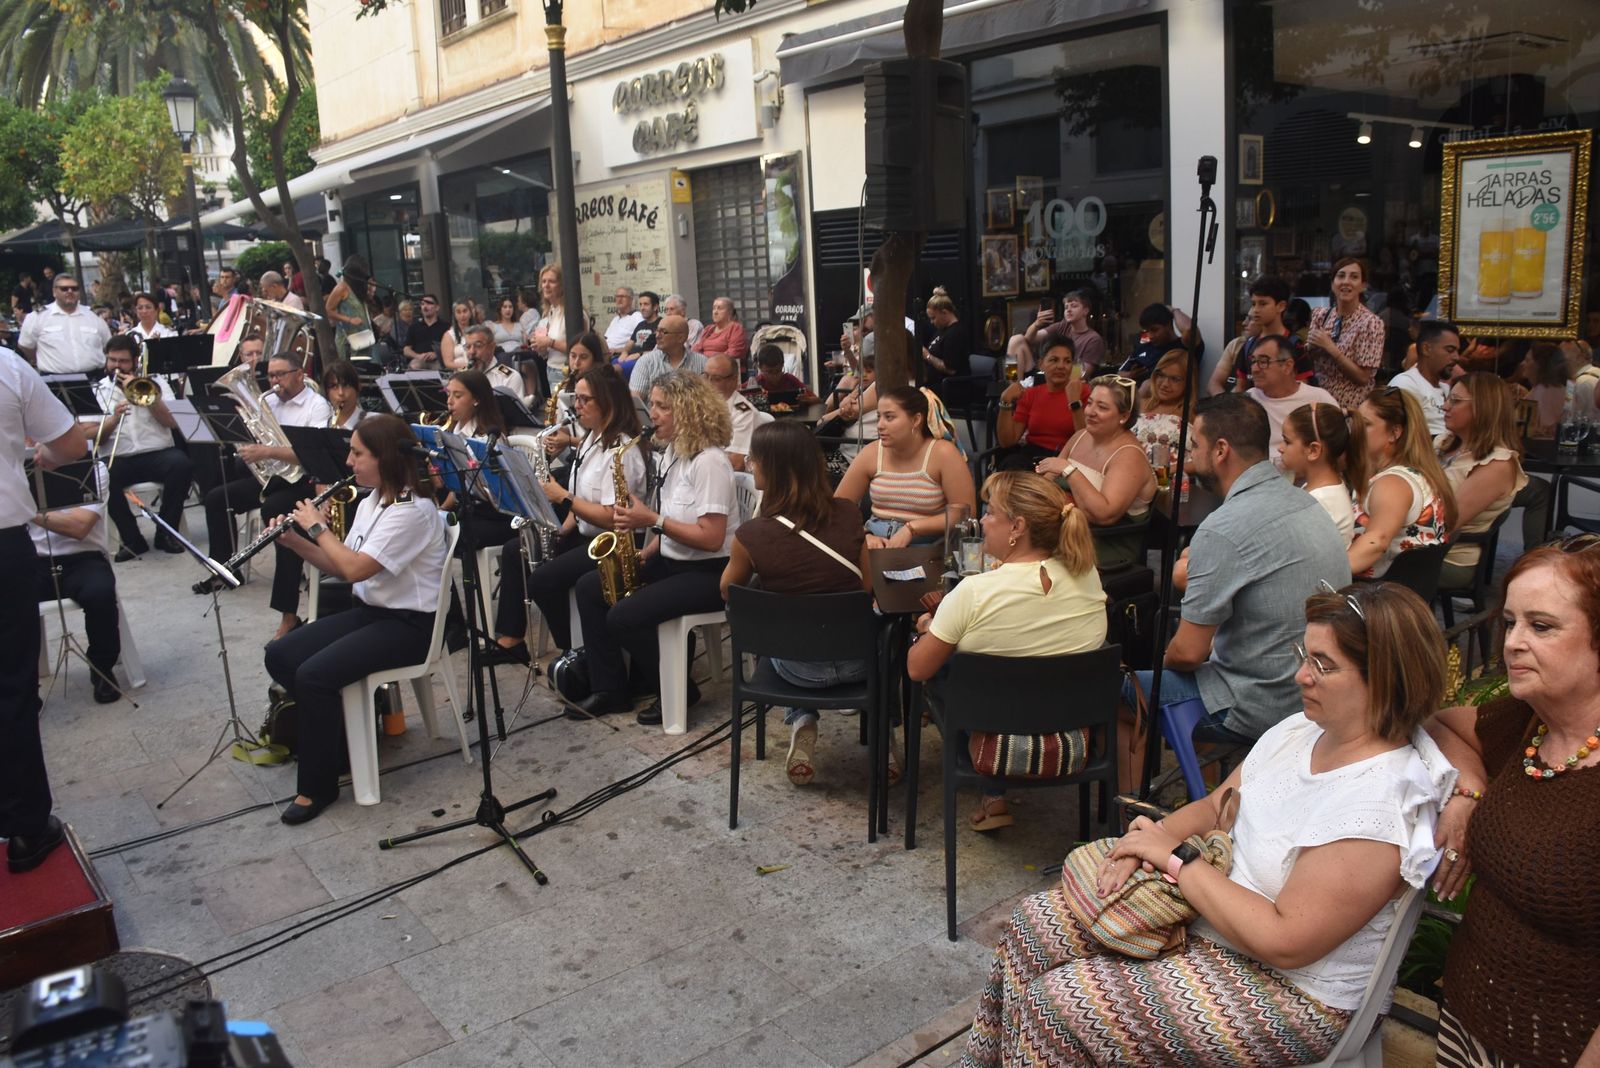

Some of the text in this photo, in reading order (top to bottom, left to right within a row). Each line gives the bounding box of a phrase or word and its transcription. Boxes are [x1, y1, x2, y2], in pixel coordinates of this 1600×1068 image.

[612, 53, 725, 115] CORREOS
[1467, 187, 1561, 209] HELADAS
[1477, 170, 1552, 199] JARRAS
[575, 195, 659, 229] RREOS CAFÉ
[1024, 196, 1107, 241] 100
[774, 303, 804, 315] CORREOS
